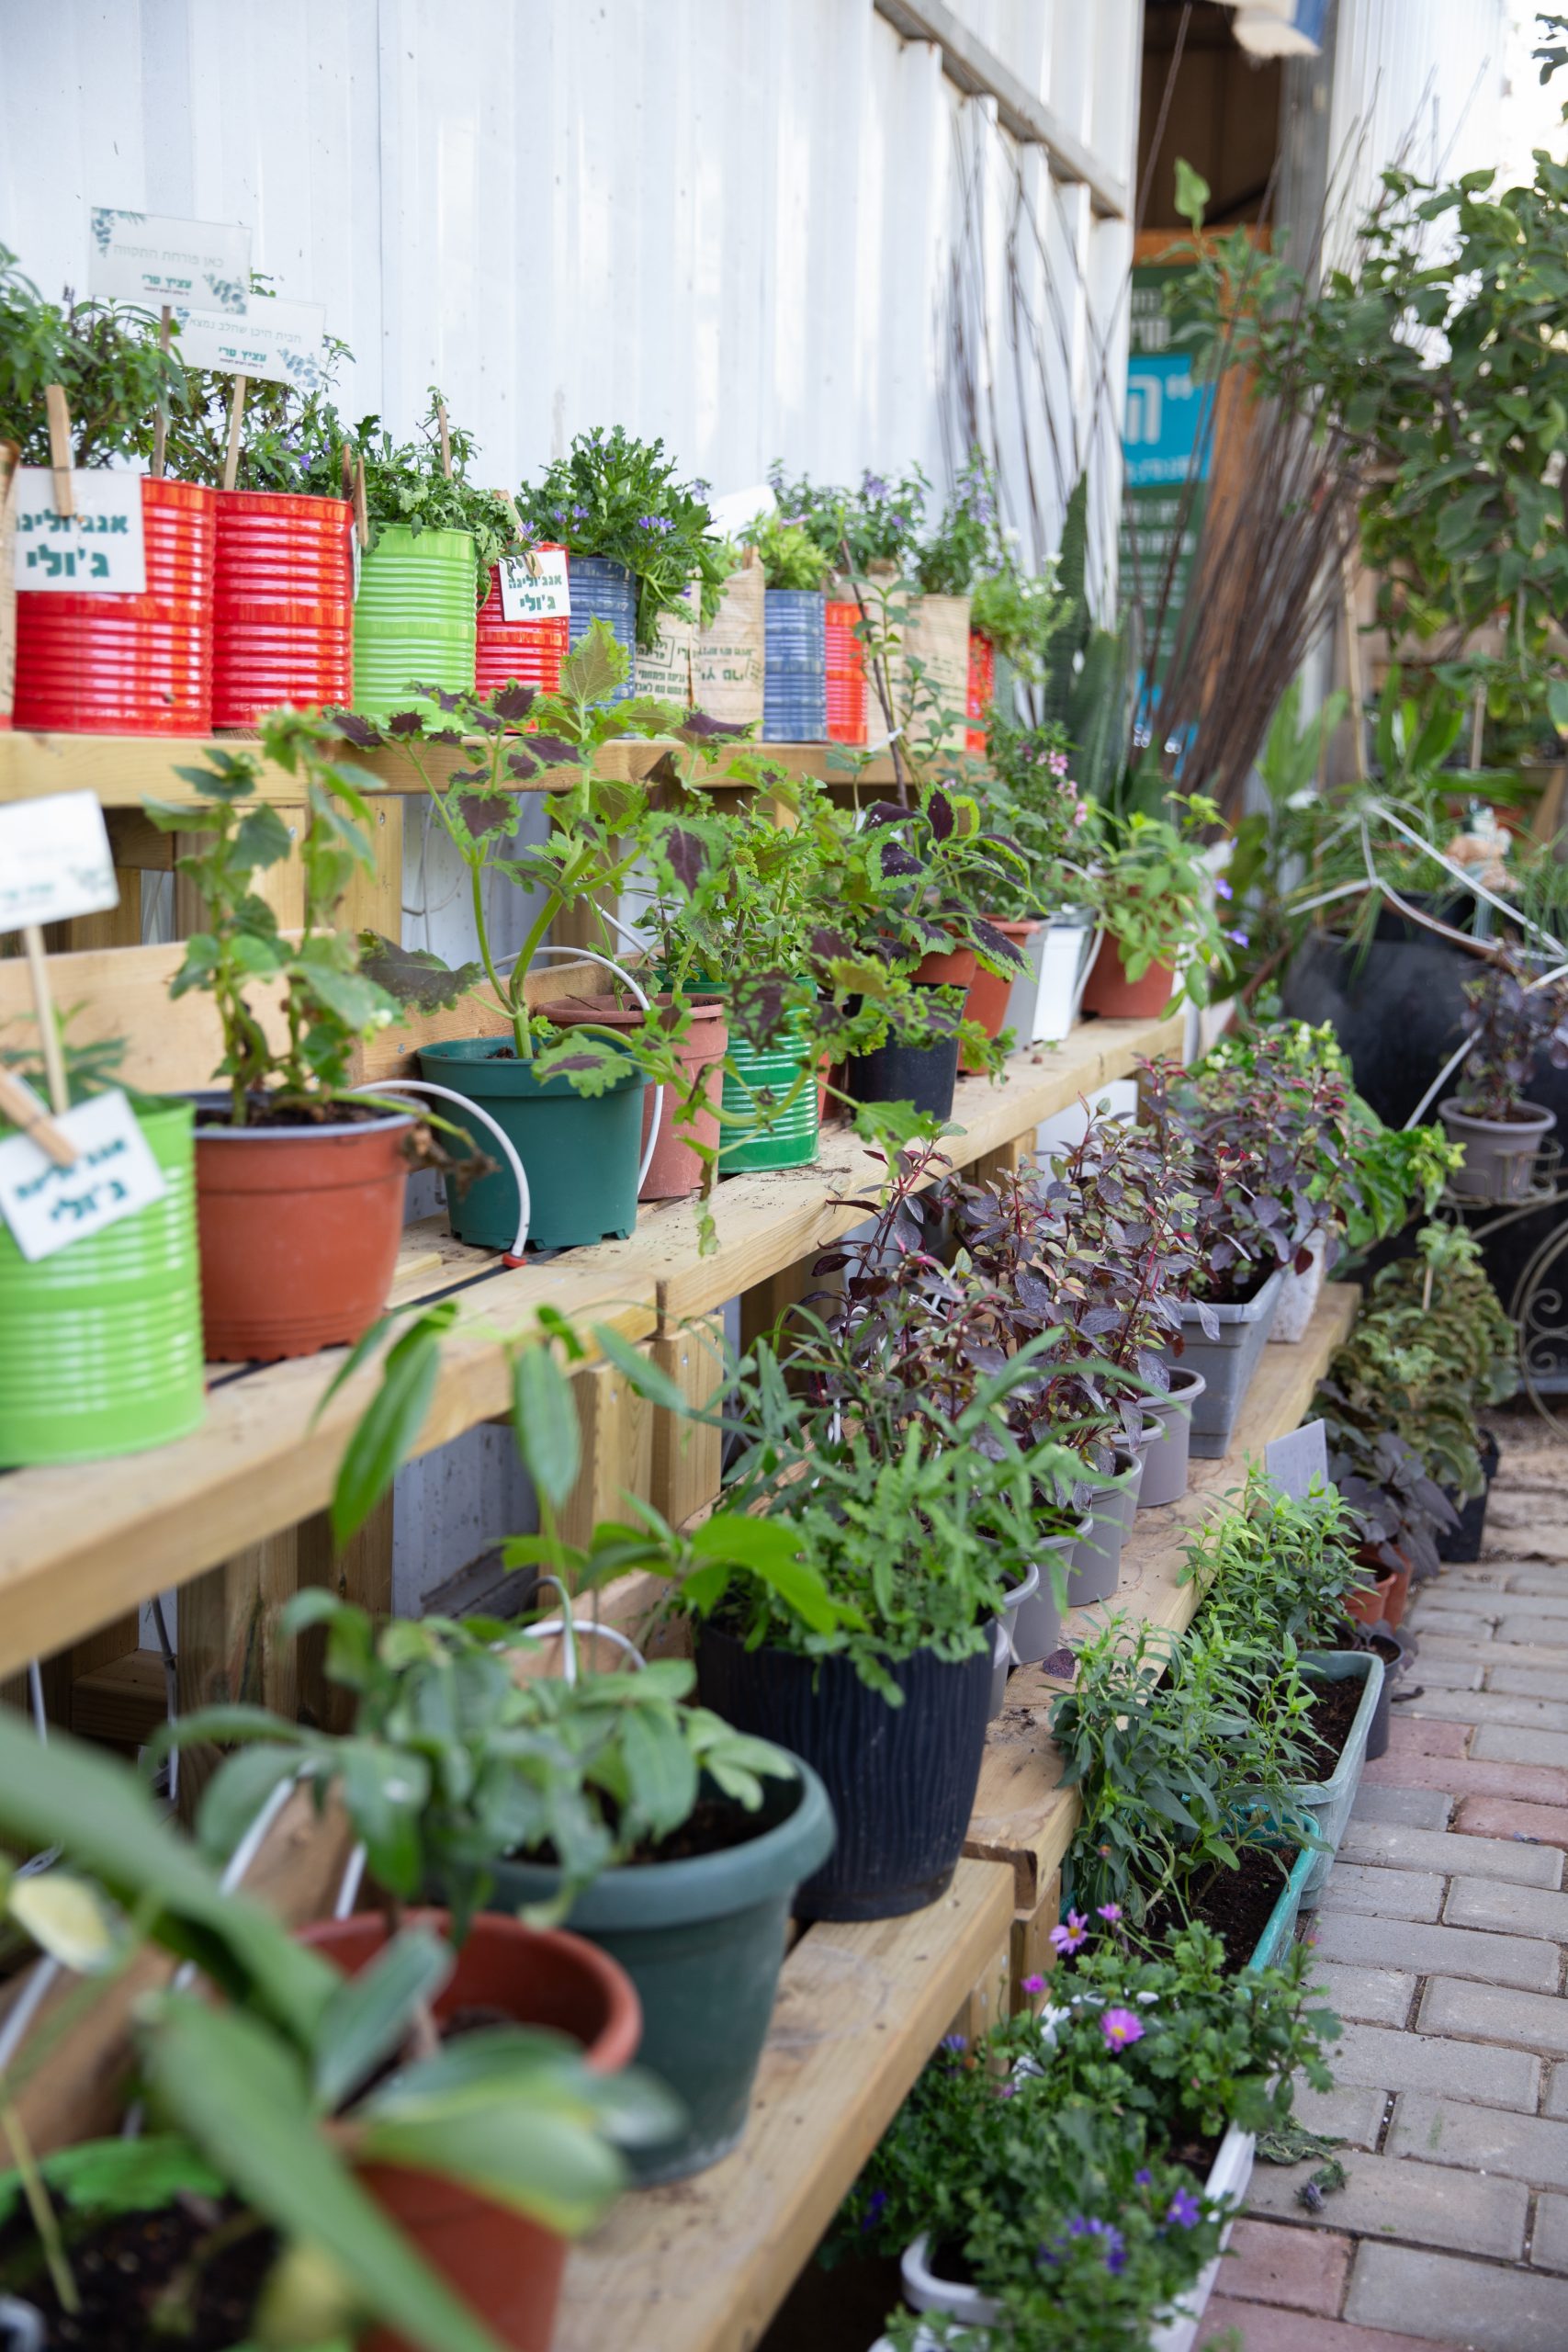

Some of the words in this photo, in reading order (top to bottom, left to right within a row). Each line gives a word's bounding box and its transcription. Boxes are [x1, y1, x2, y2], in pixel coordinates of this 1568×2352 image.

[16, 508, 129, 534] אנג'ולינ
[27, 543, 110, 578] ג'ולי
[519, 593, 557, 612] ג'ולי
